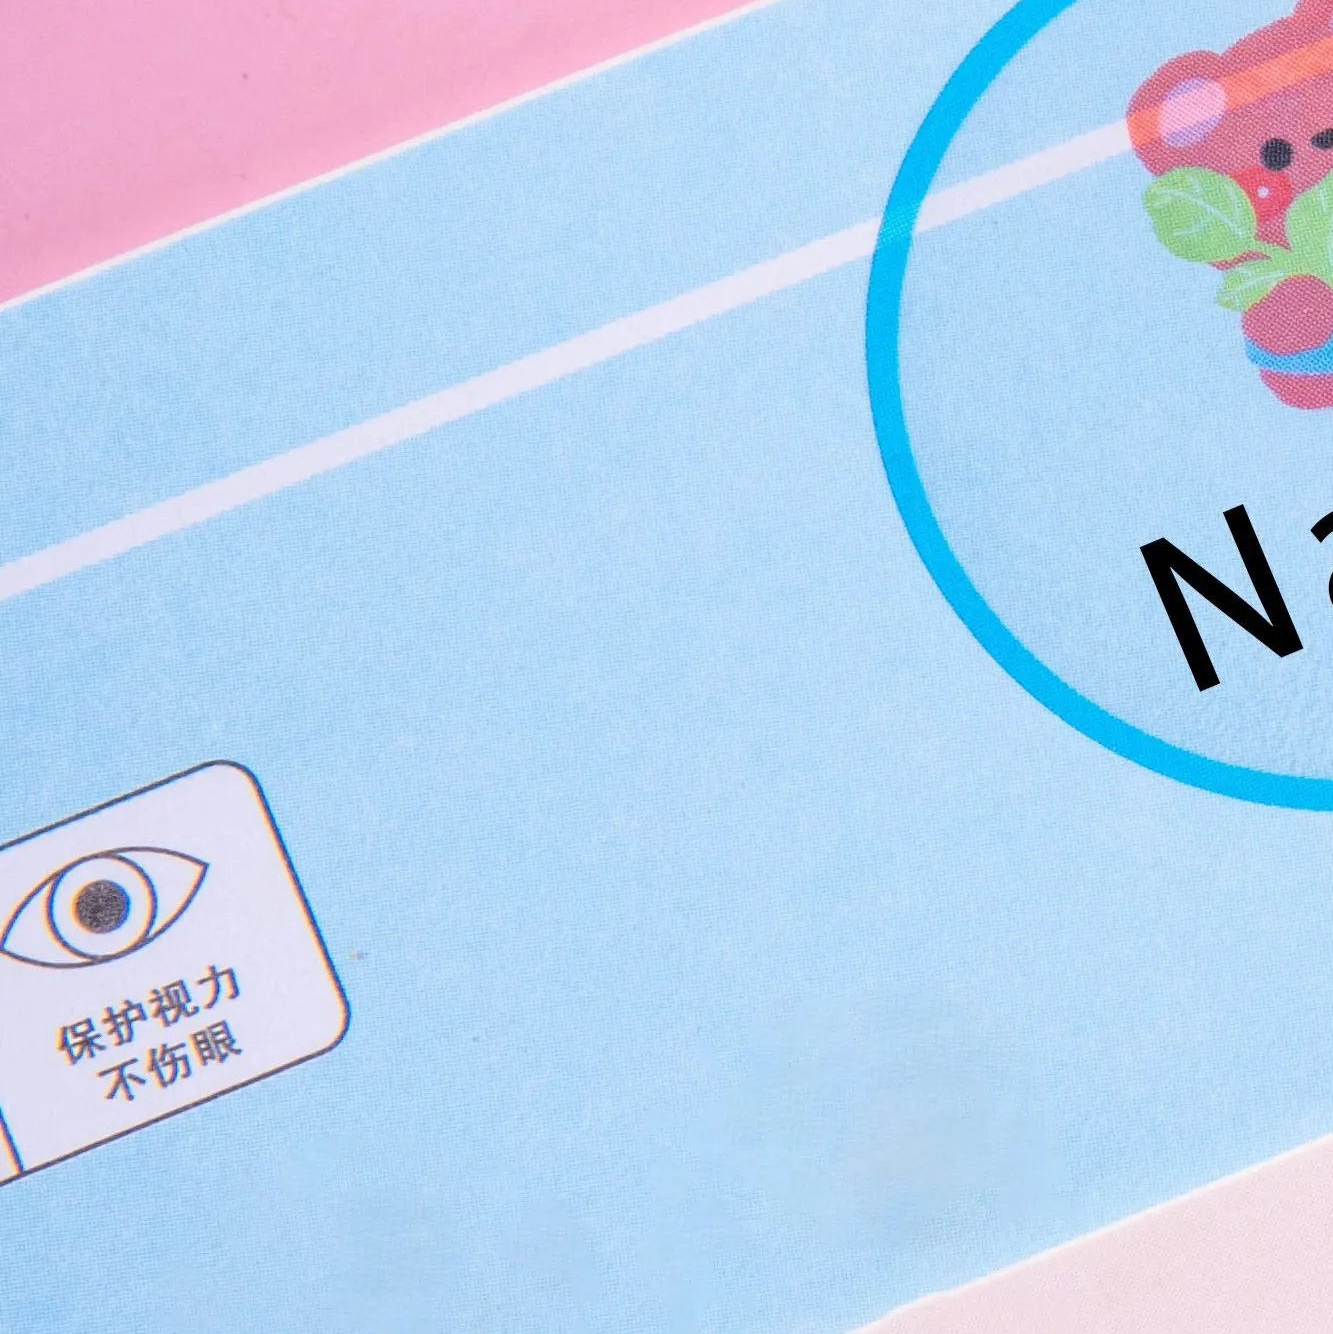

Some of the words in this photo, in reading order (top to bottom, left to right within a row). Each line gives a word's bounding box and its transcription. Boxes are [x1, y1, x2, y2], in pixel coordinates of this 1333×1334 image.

[56, 964, 241, 1066] 保护视力
[97, 1020, 243, 1102] 不伤眼
